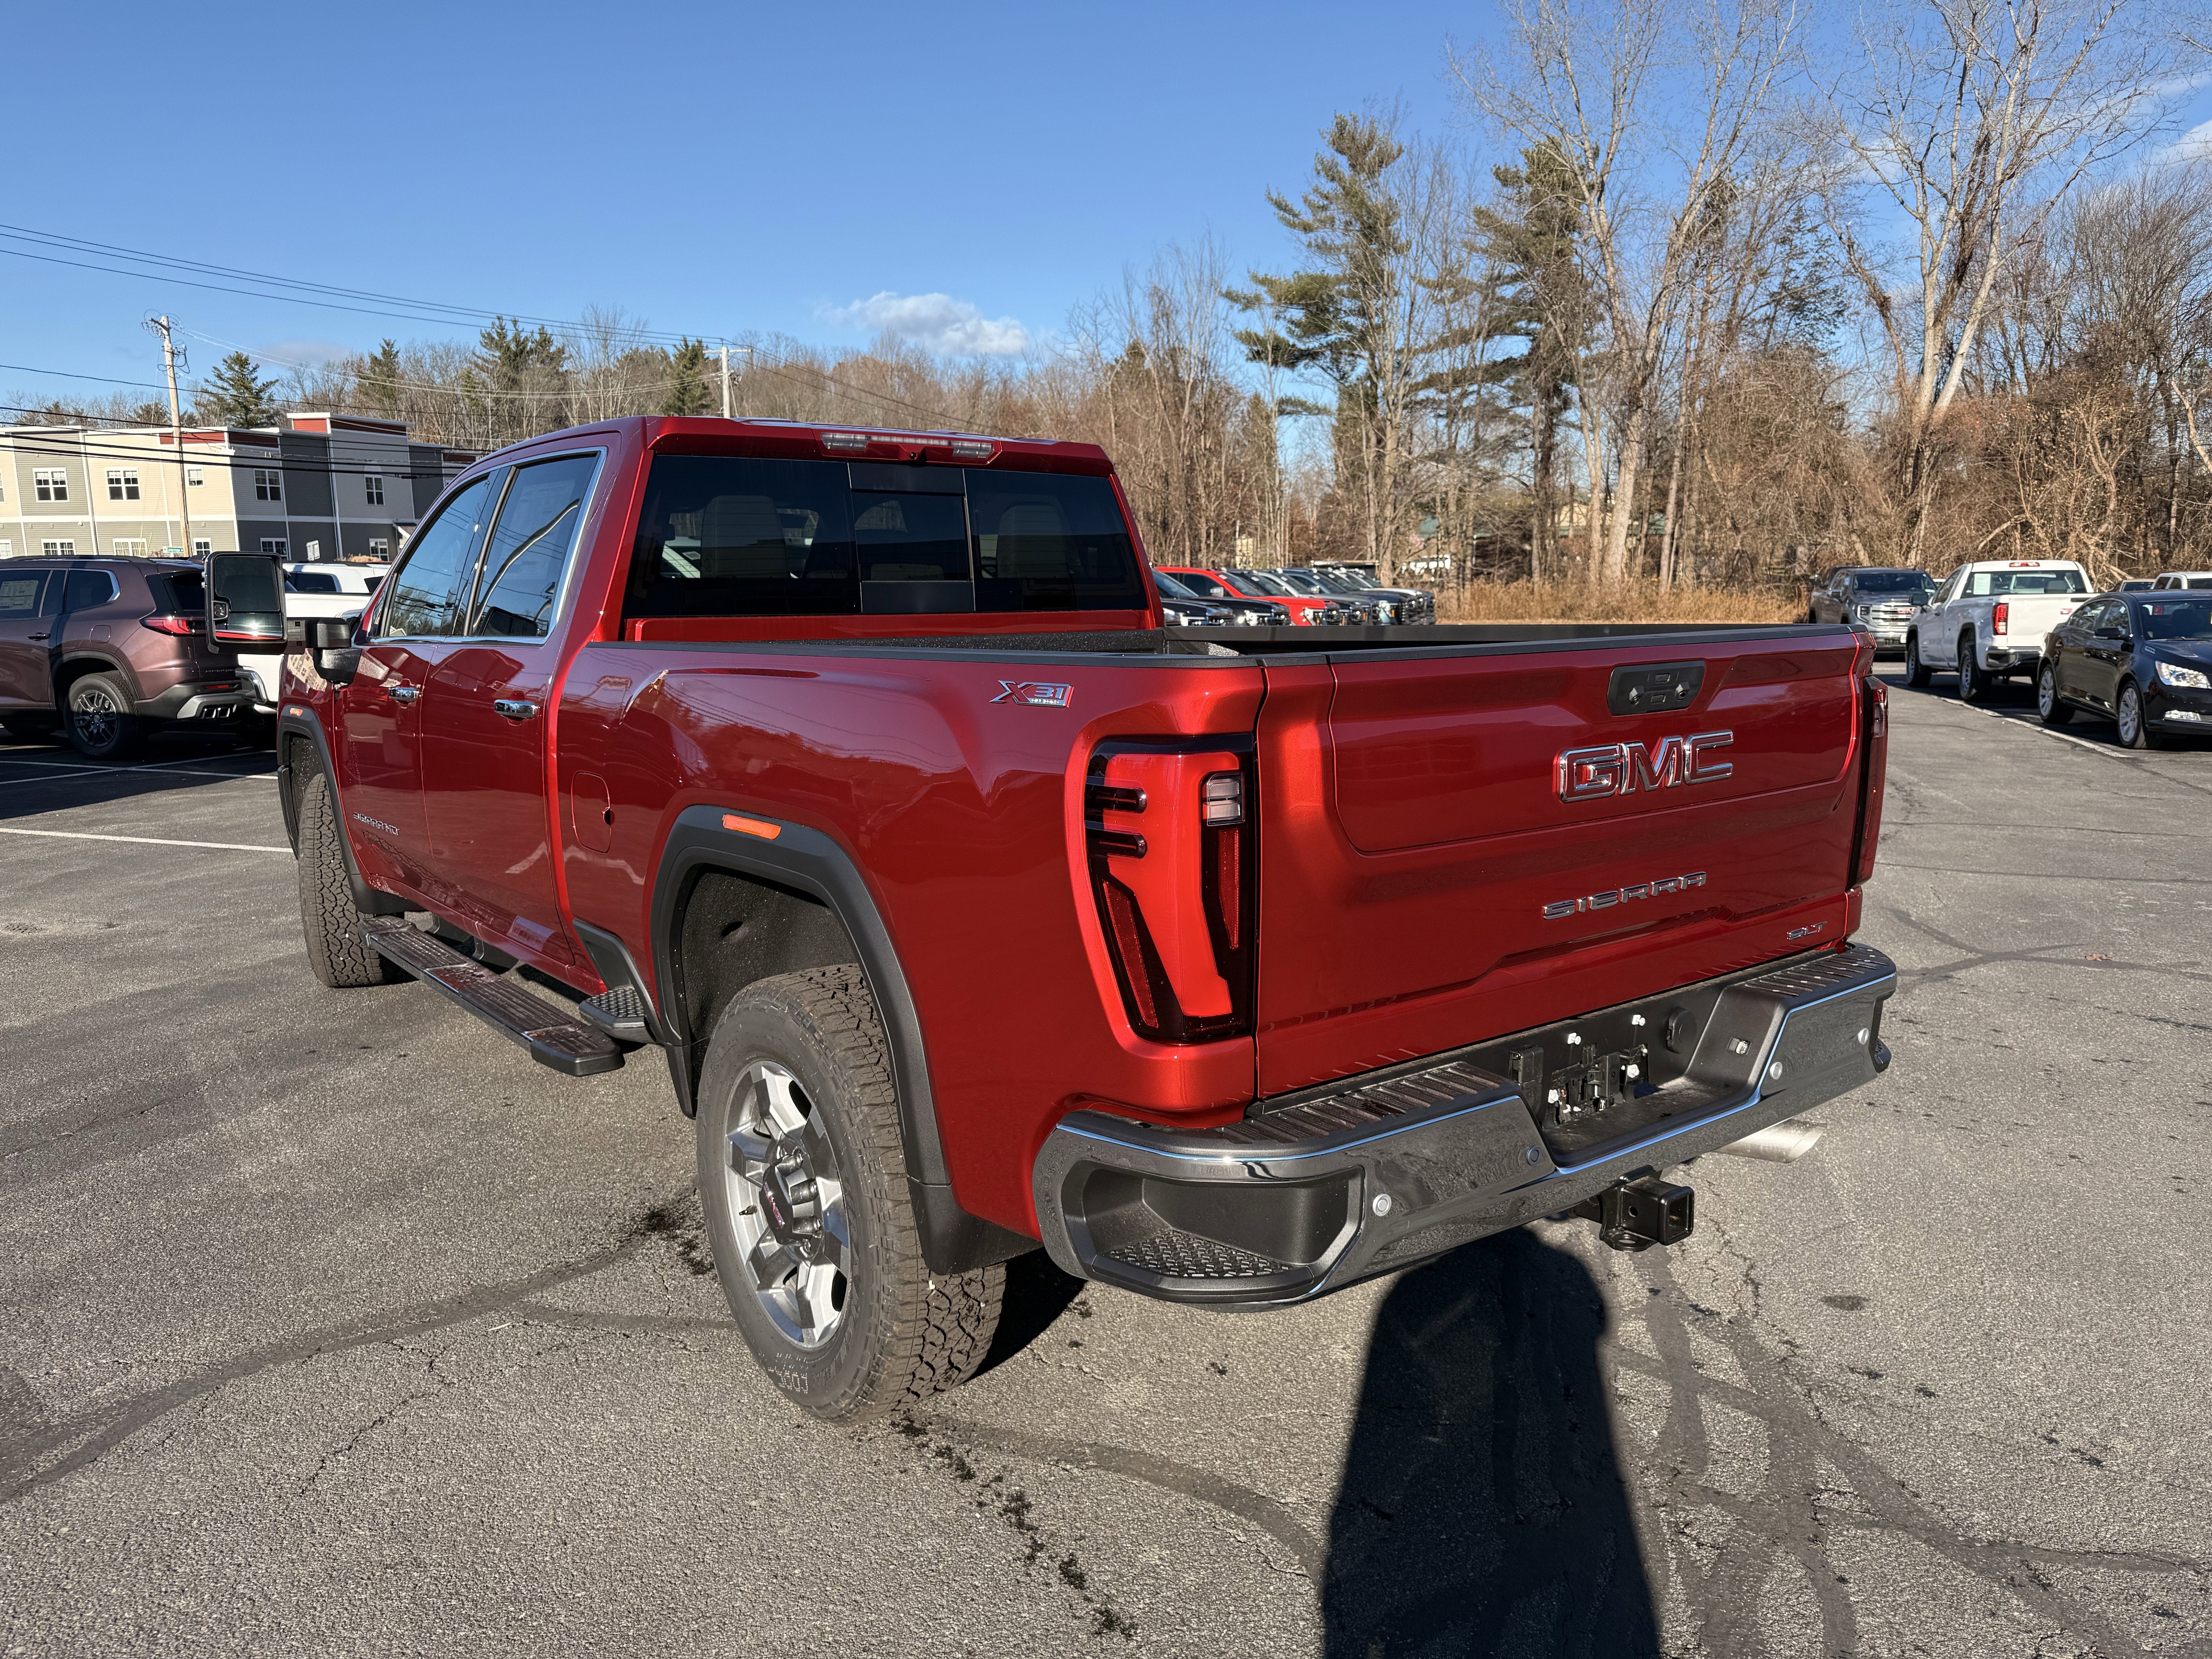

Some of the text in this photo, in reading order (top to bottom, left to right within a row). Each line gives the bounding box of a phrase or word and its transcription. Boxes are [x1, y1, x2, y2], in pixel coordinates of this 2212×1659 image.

[989, 680, 1074, 708] X31
[1556, 729, 1733, 803] GMC
[1542, 871, 1706, 920] SIERRA
[1786, 921, 1828, 941] SLT
